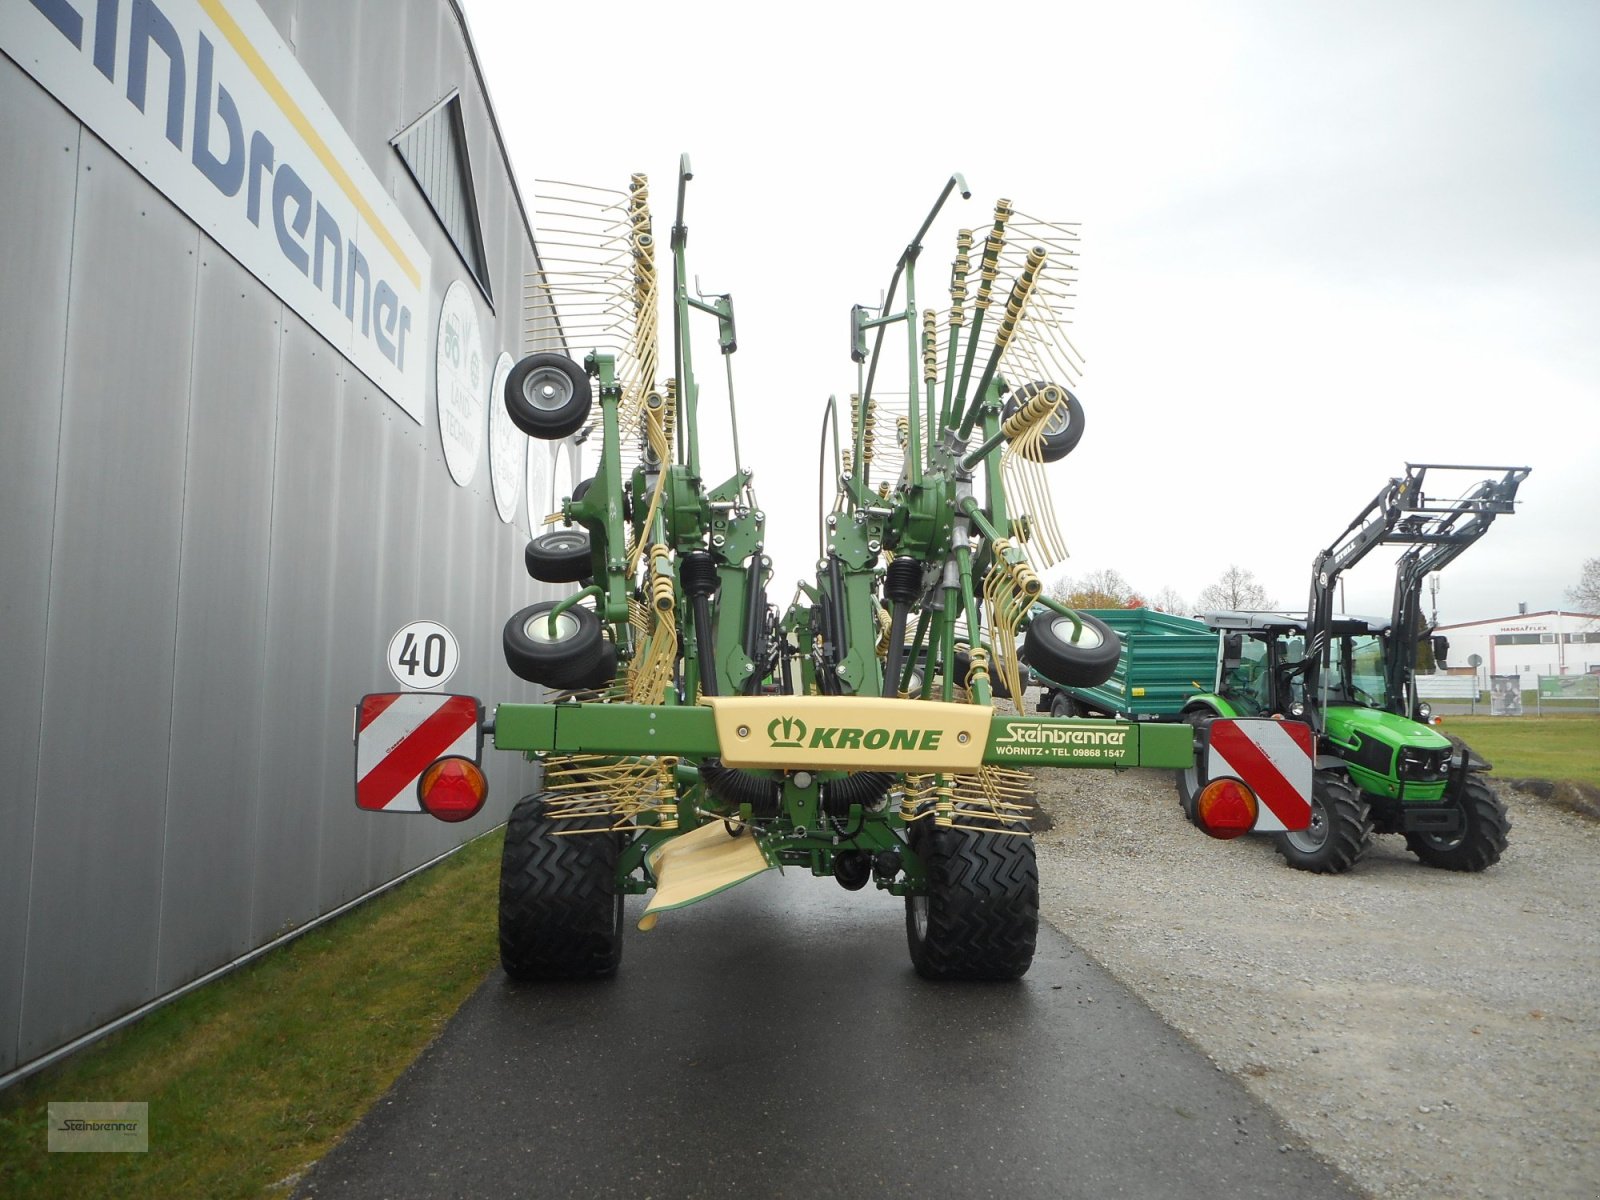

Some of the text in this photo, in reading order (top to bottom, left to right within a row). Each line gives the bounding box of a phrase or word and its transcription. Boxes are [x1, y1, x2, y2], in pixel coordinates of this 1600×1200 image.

[398, 632, 447, 678] 40
[808, 727, 944, 751] KRONE
[996, 722, 1127, 745] Steinbrenner
[996, 745, 1126, 758] WÖRNITZ TEL 09868 1547
